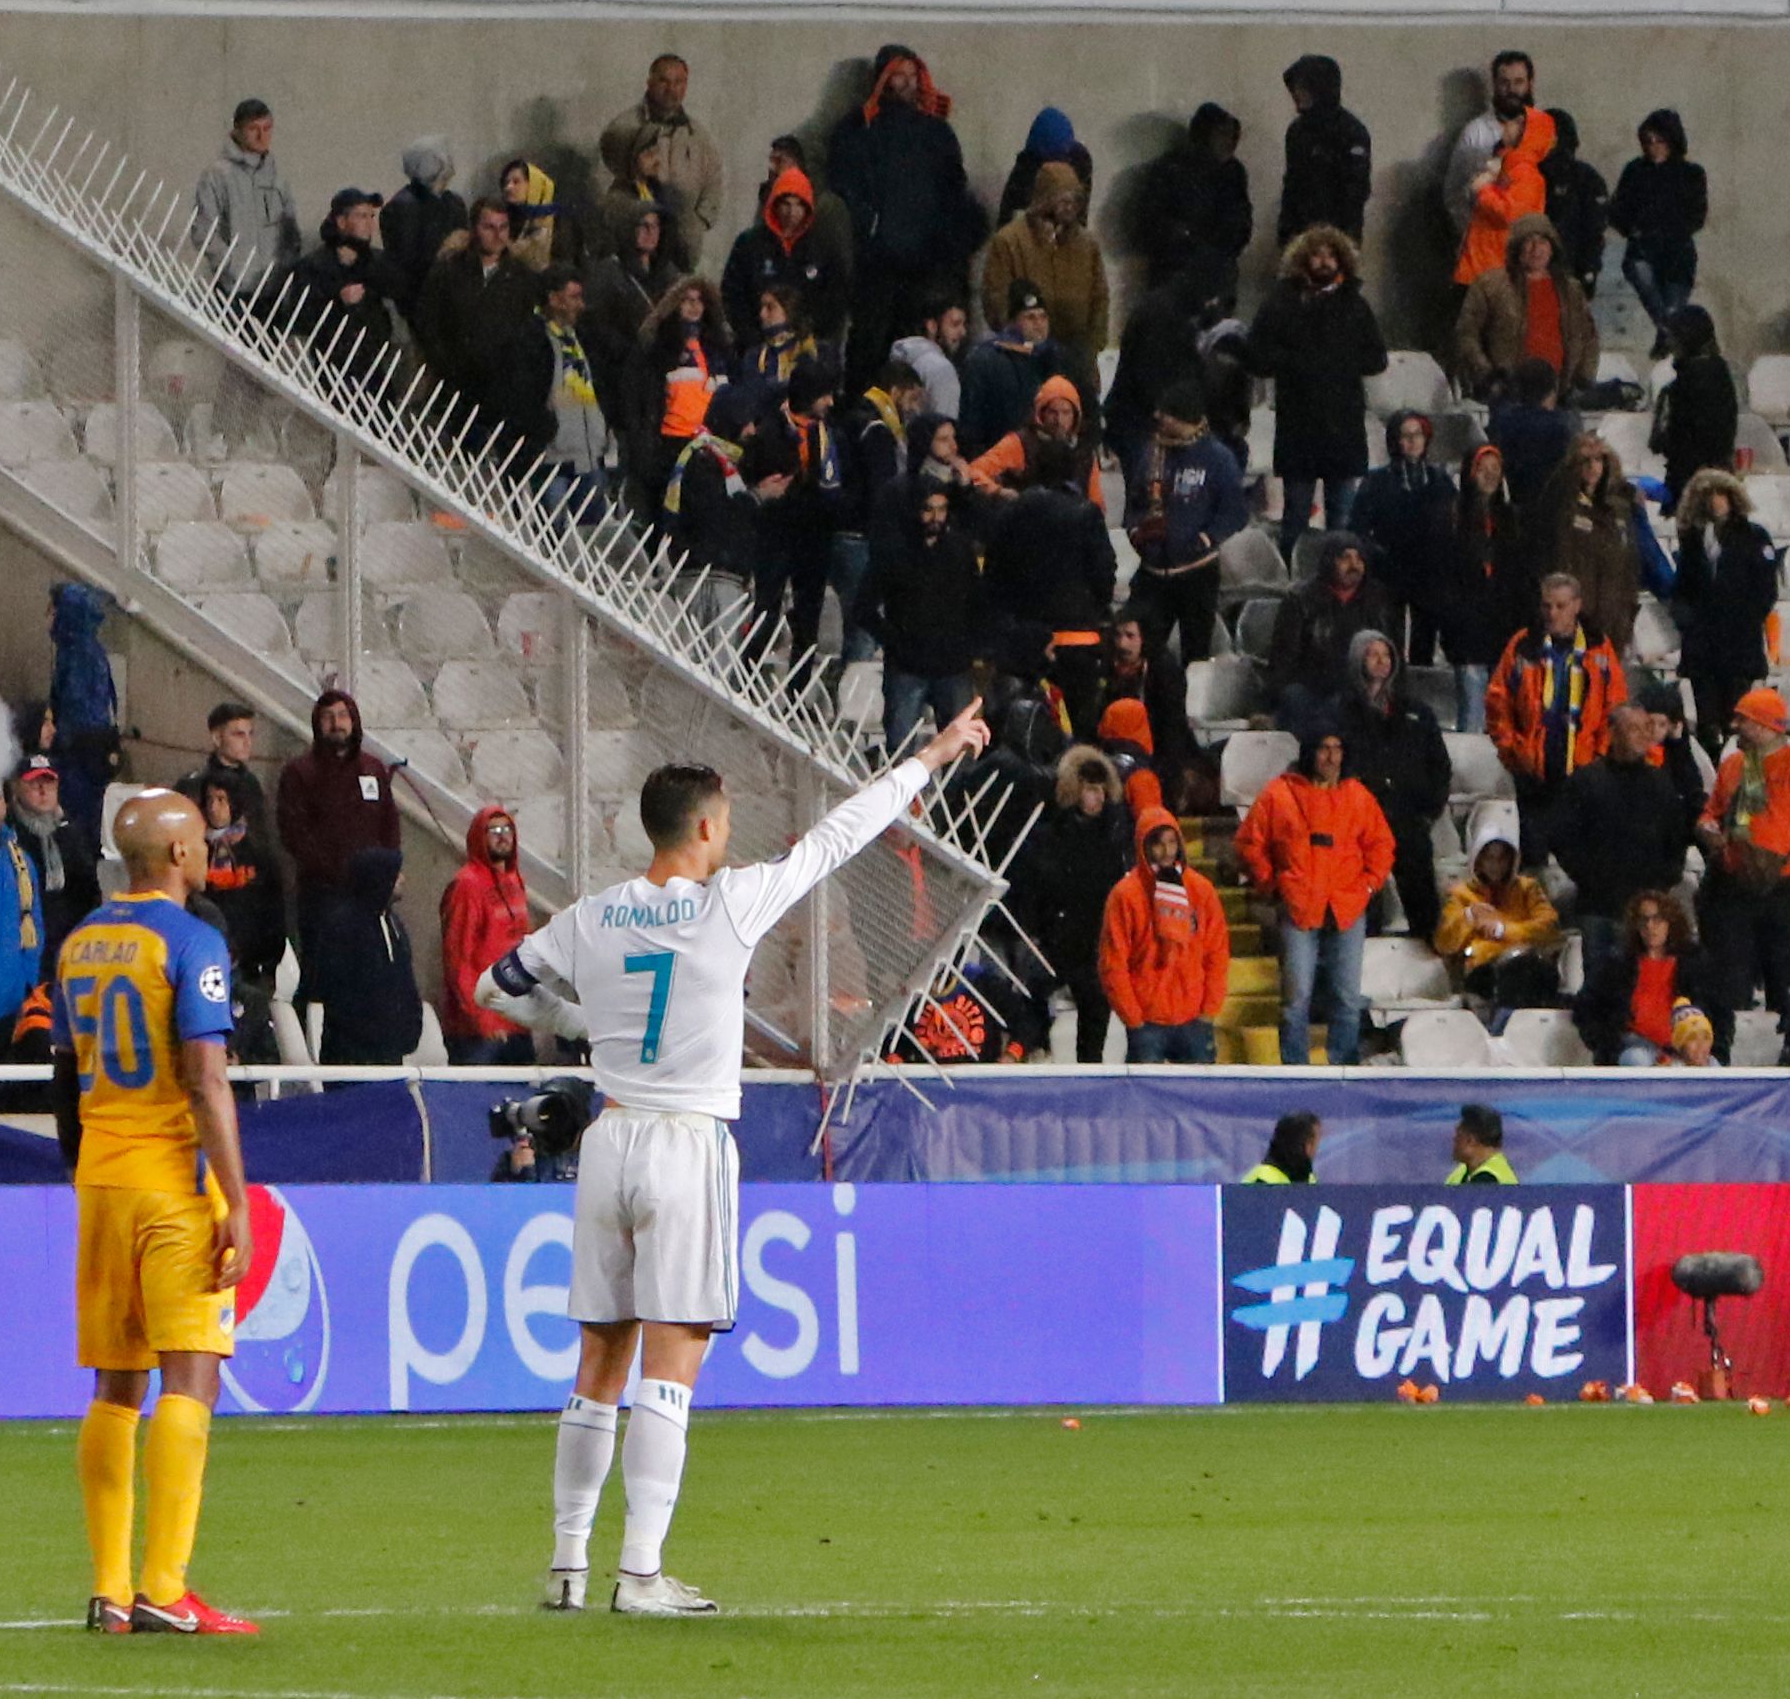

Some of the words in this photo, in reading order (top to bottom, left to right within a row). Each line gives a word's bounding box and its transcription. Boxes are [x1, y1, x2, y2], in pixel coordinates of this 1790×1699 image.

[601, 899, 697, 930] RONALDO
[63, 975, 155, 1091] 50
[622, 951, 677, 1066] 7
[388, 1182, 861, 1411] pesi
[1355, 1293, 1585, 1381] GAME
